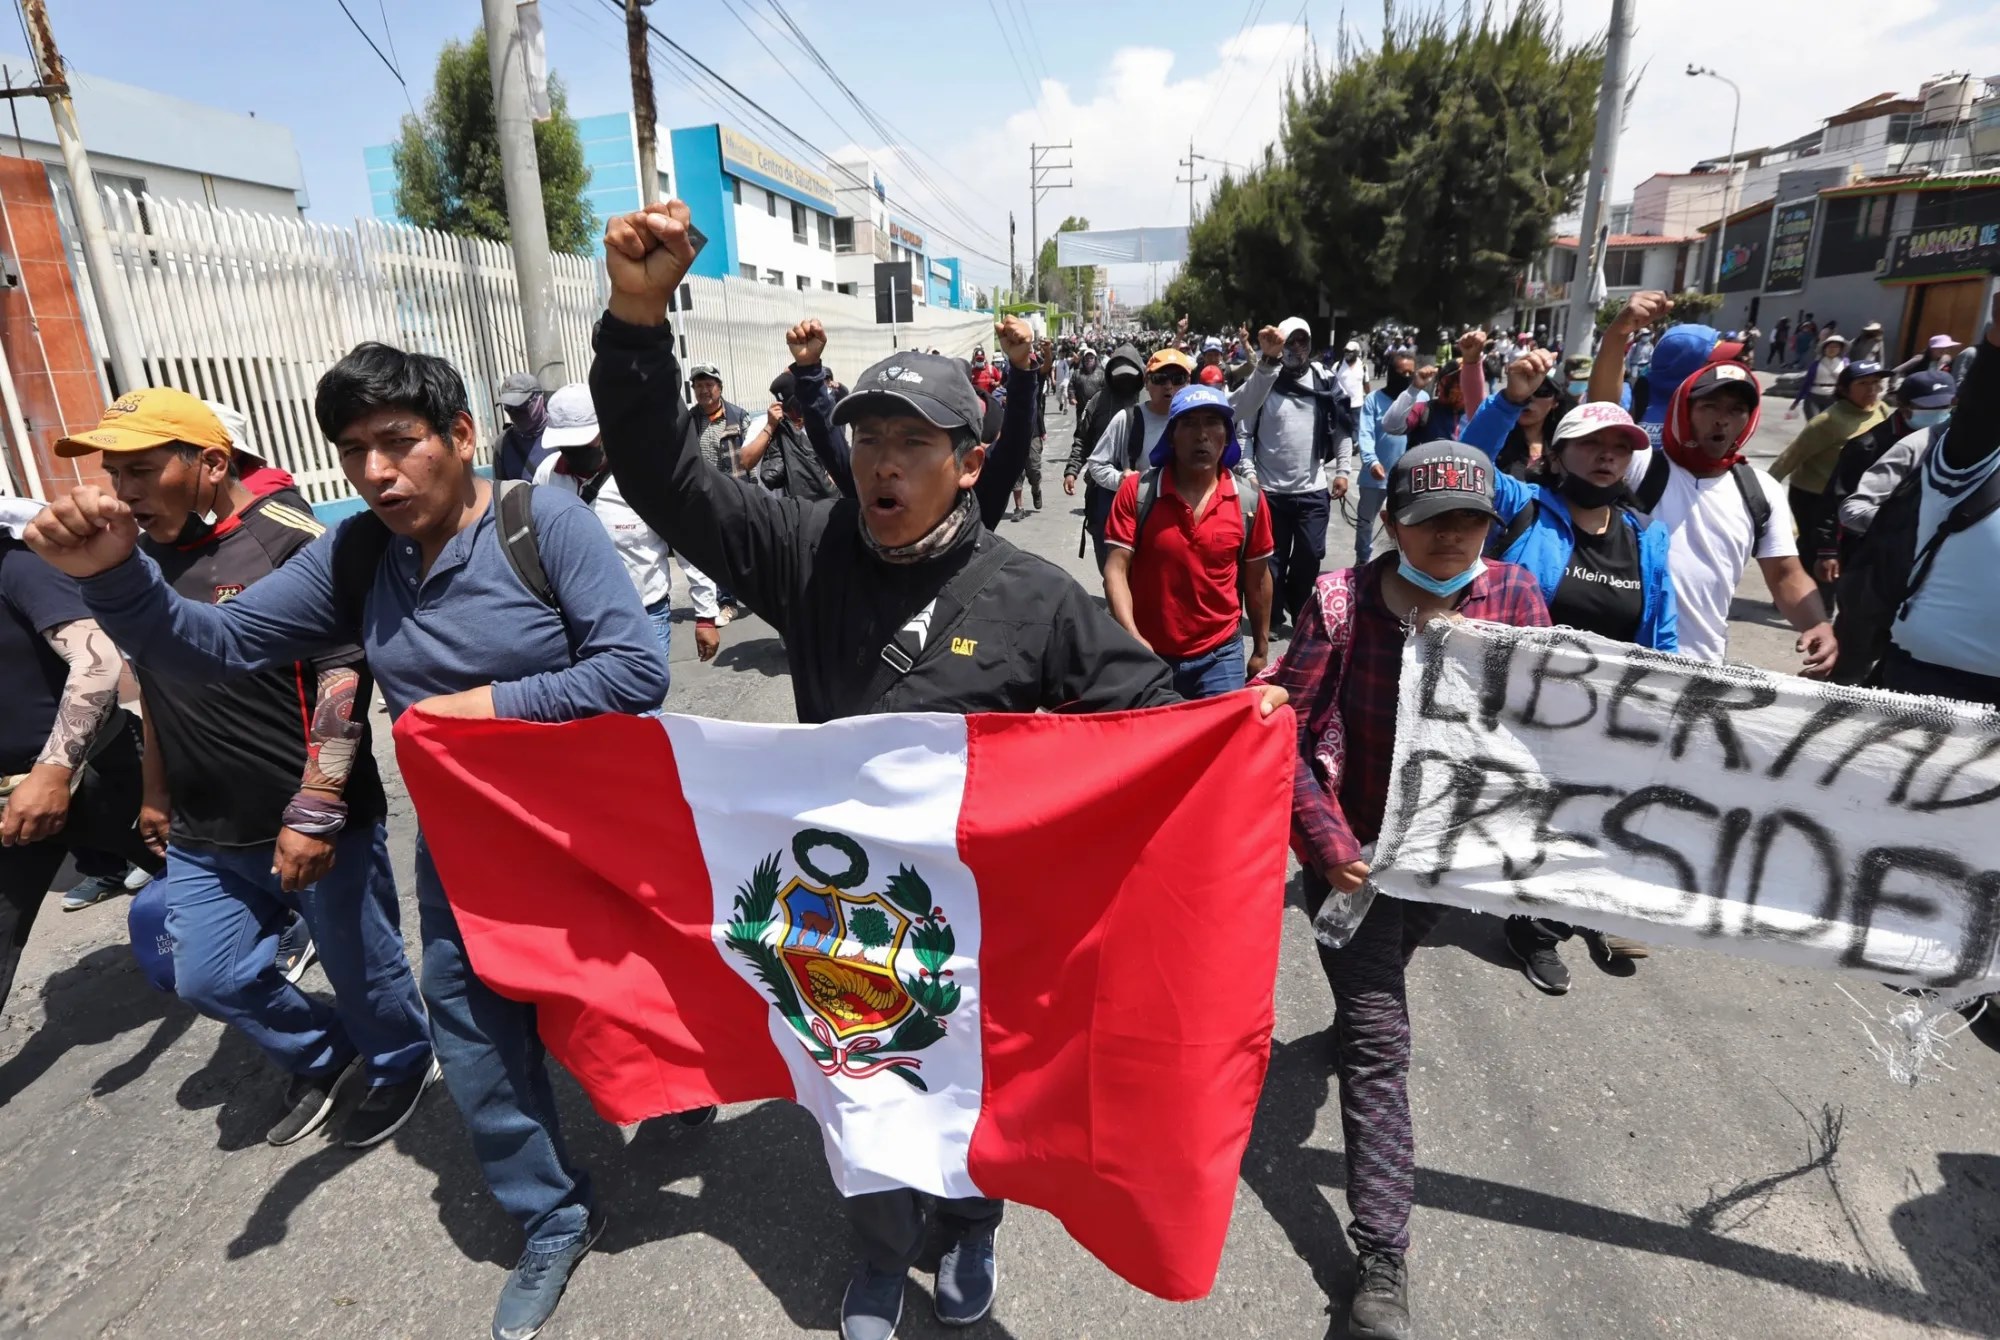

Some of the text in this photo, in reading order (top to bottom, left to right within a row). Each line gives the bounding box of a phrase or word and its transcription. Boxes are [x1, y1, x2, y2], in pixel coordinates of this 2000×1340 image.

[757, 151, 784, 179] Centro
[1423, 455, 1477, 466] CHICAGO
[1572, 565, 1608, 584] Klein
[1608, 575, 1641, 590] Jeans
[950, 637, 978, 656] CAT
